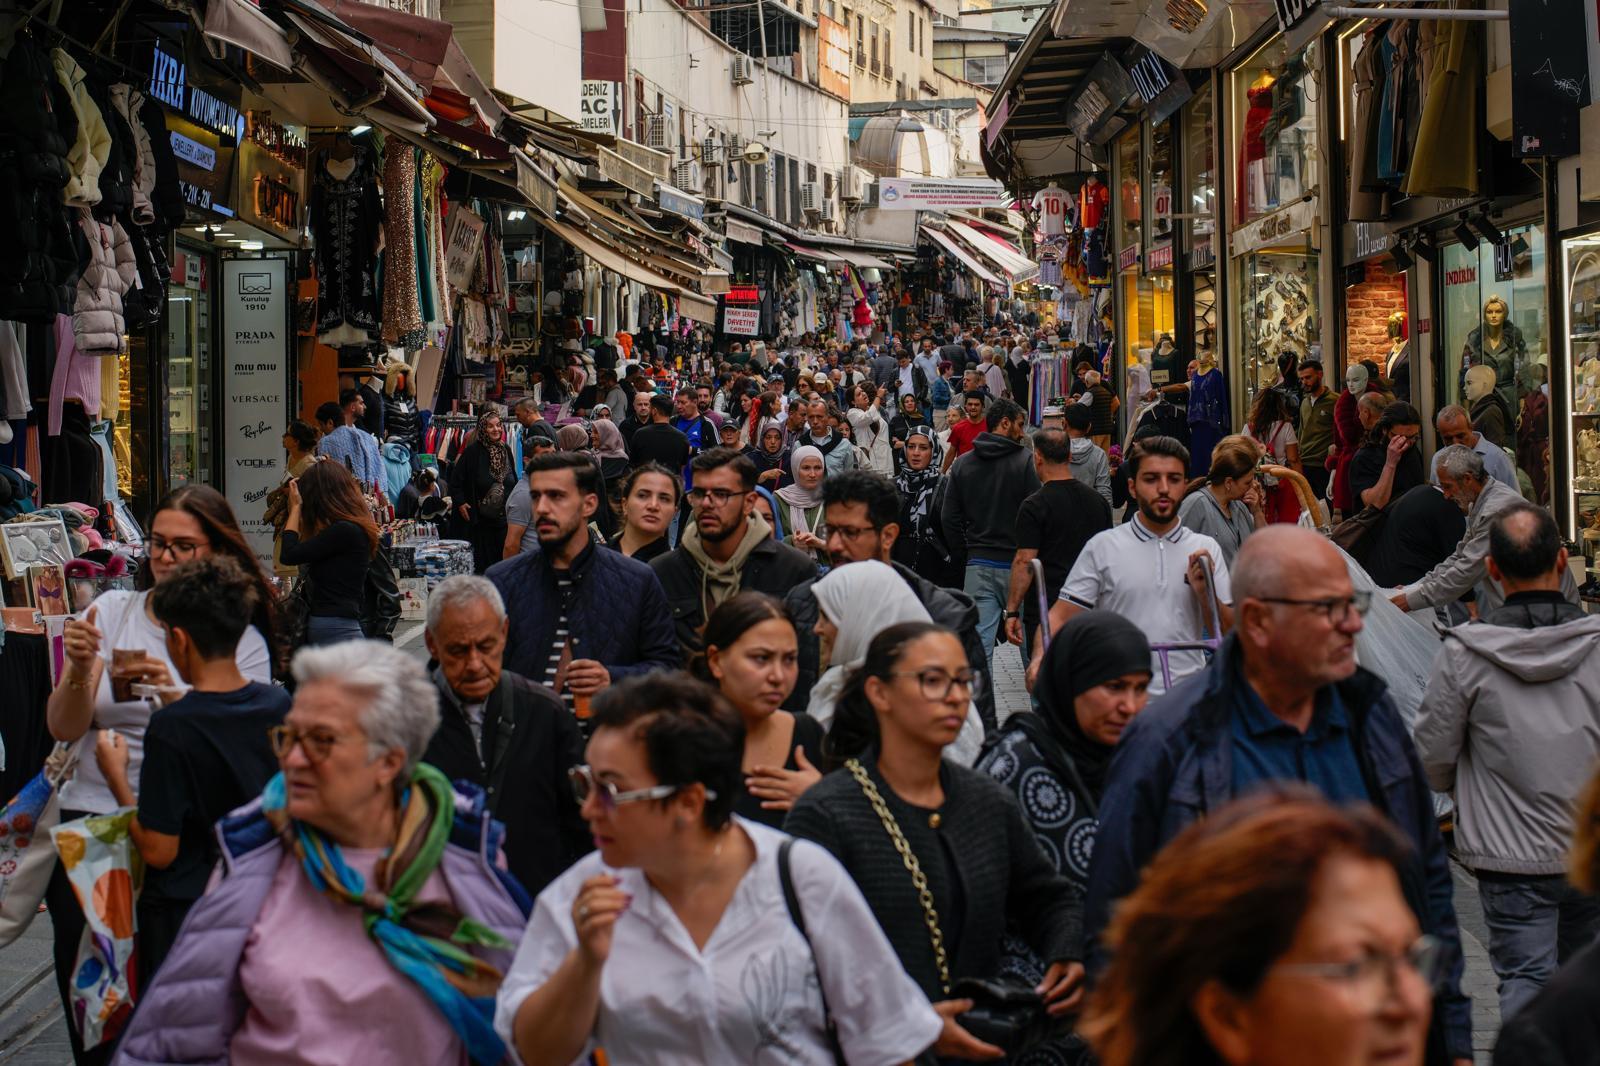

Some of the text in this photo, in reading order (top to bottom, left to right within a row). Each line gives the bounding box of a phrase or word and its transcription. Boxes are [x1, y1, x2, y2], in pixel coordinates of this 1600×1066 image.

[150, 36, 185, 111] İKRA
[1131, 50, 1170, 104] OLCAY
[581, 81, 608, 96] DENİZ
[1044, 198, 1060, 215] 10
[240, 296, 270, 304] Kuruluş
[245, 303, 267, 311] 1910
[235, 331, 276, 340] PRADA
[232, 395, 281, 403] VERSACE
[236, 459, 277, 468] VOGUE
